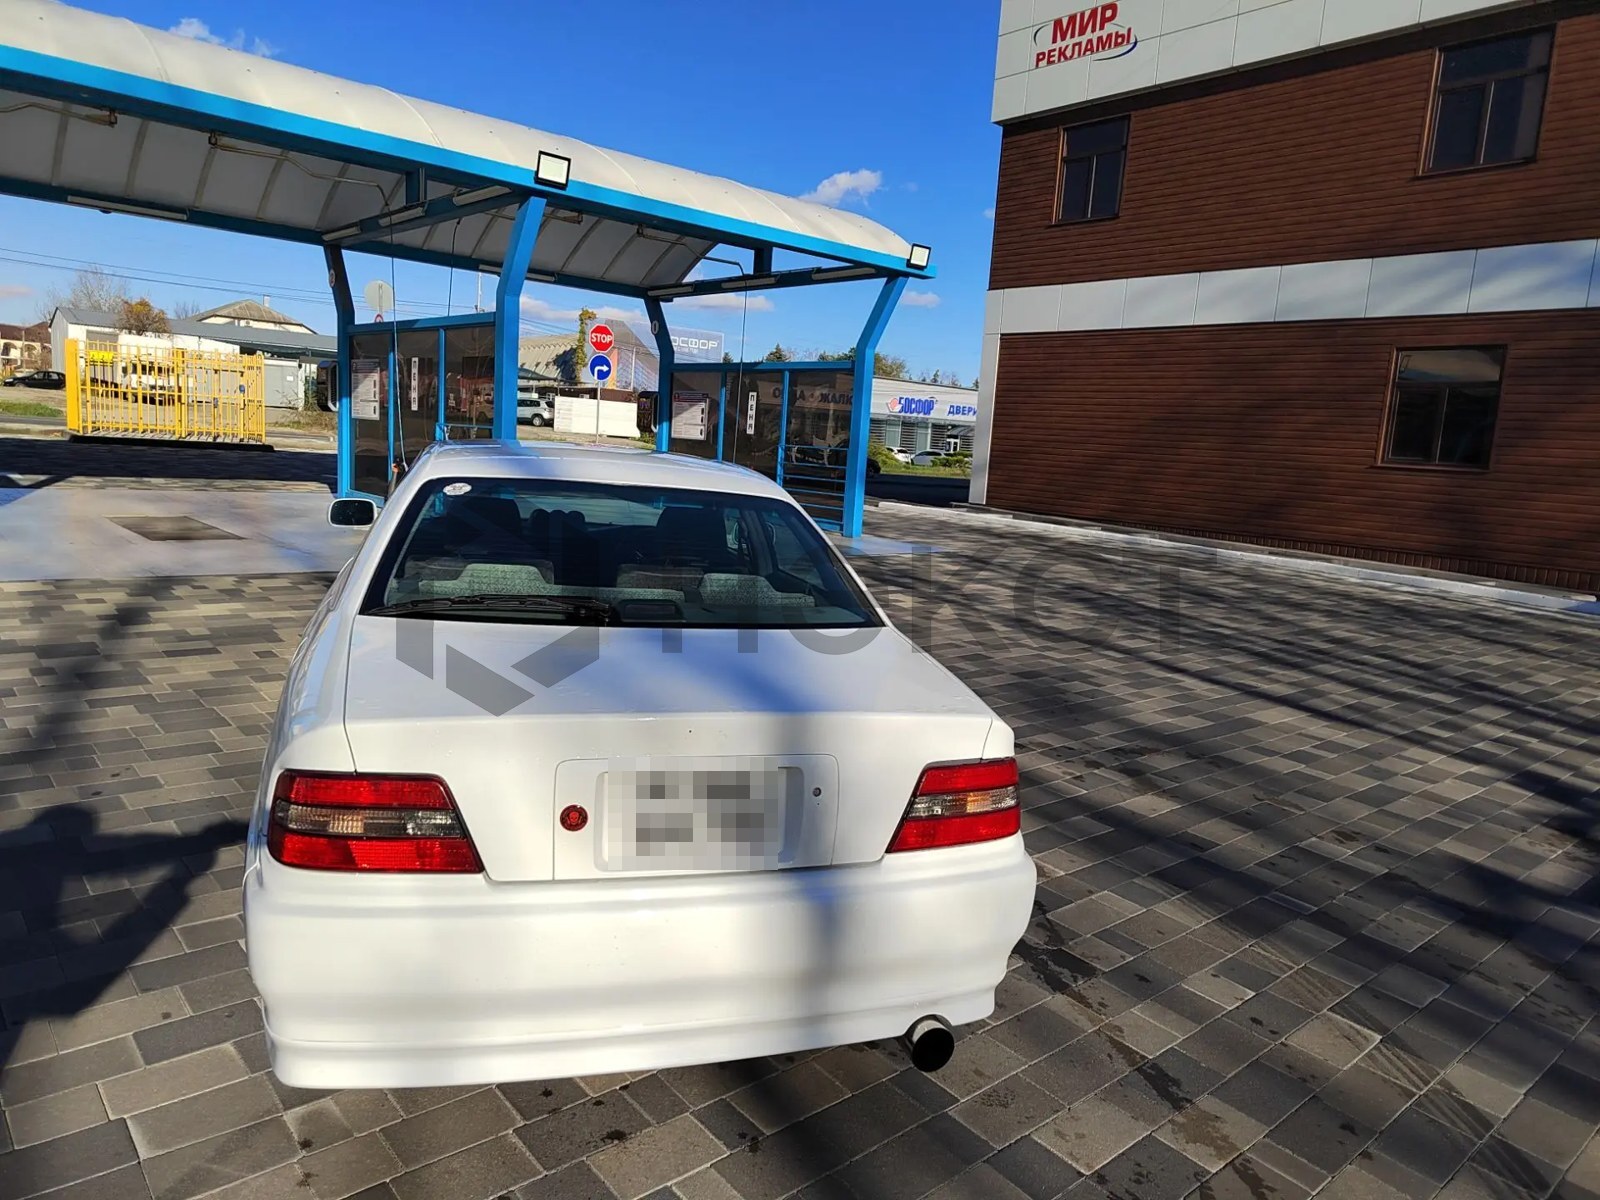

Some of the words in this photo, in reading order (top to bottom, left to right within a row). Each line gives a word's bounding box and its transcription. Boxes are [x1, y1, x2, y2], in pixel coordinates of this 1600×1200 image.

[1051, 2, 1118, 44] МИР
[1035, 27, 1132, 68] РЕКЛАМЫ
[591, 333, 613, 344] STOP
[670, 336, 718, 350] ОСФОР
[898, 396, 935, 416] БОСФОР
